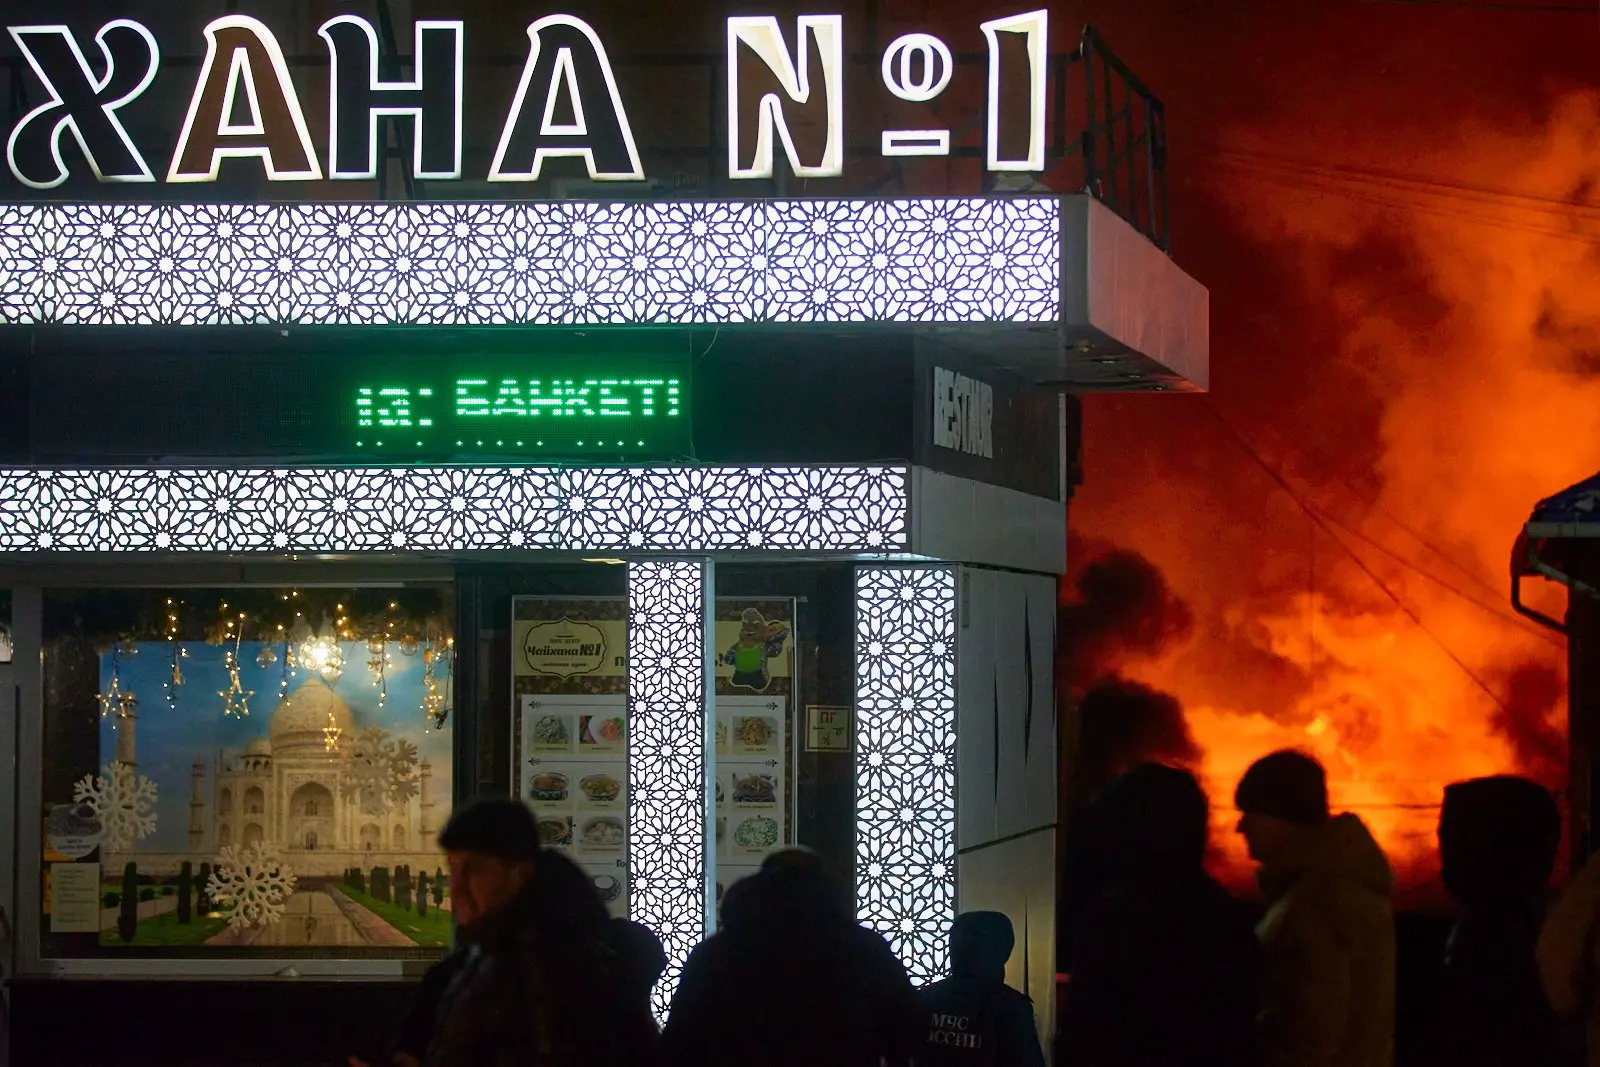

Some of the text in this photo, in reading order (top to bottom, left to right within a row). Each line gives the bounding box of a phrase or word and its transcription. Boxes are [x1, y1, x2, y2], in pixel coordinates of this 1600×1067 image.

[6, 14, 646, 189] ХАНА
[527, 644, 579, 657] Чайхана
[931, 1012, 970, 1030] МЧС
